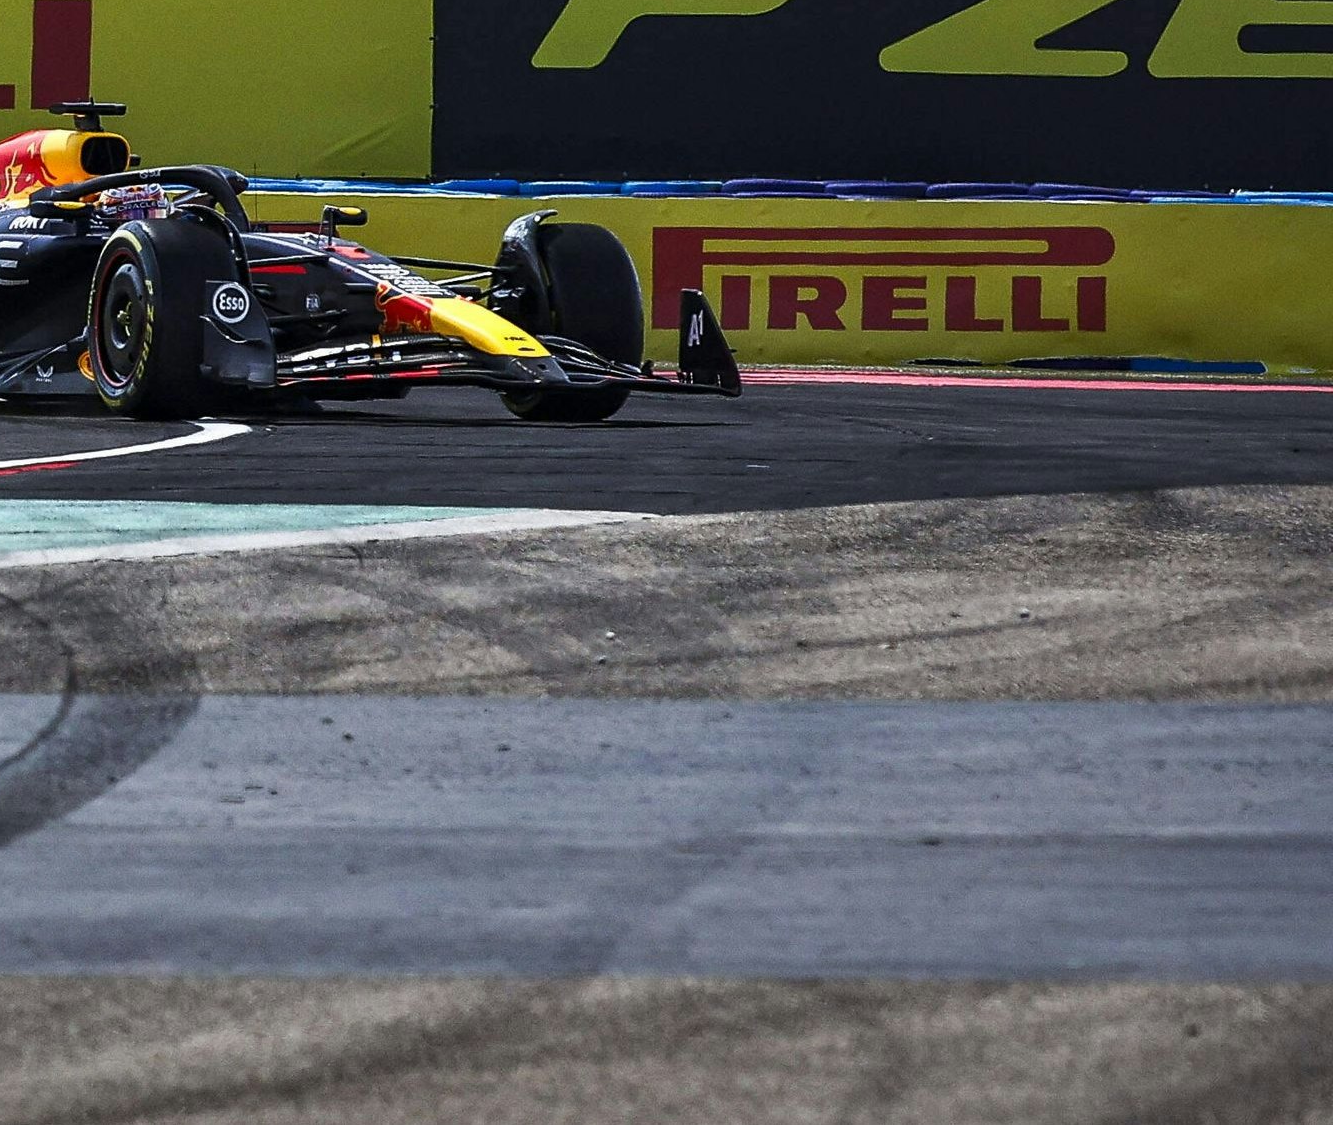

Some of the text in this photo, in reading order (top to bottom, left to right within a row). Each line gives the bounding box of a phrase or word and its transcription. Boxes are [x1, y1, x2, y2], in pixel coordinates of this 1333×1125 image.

[117, 201, 157, 212] ORACLE
[652, 226, 1116, 331] PIRELLI
[219, 293, 244, 311] Esso
